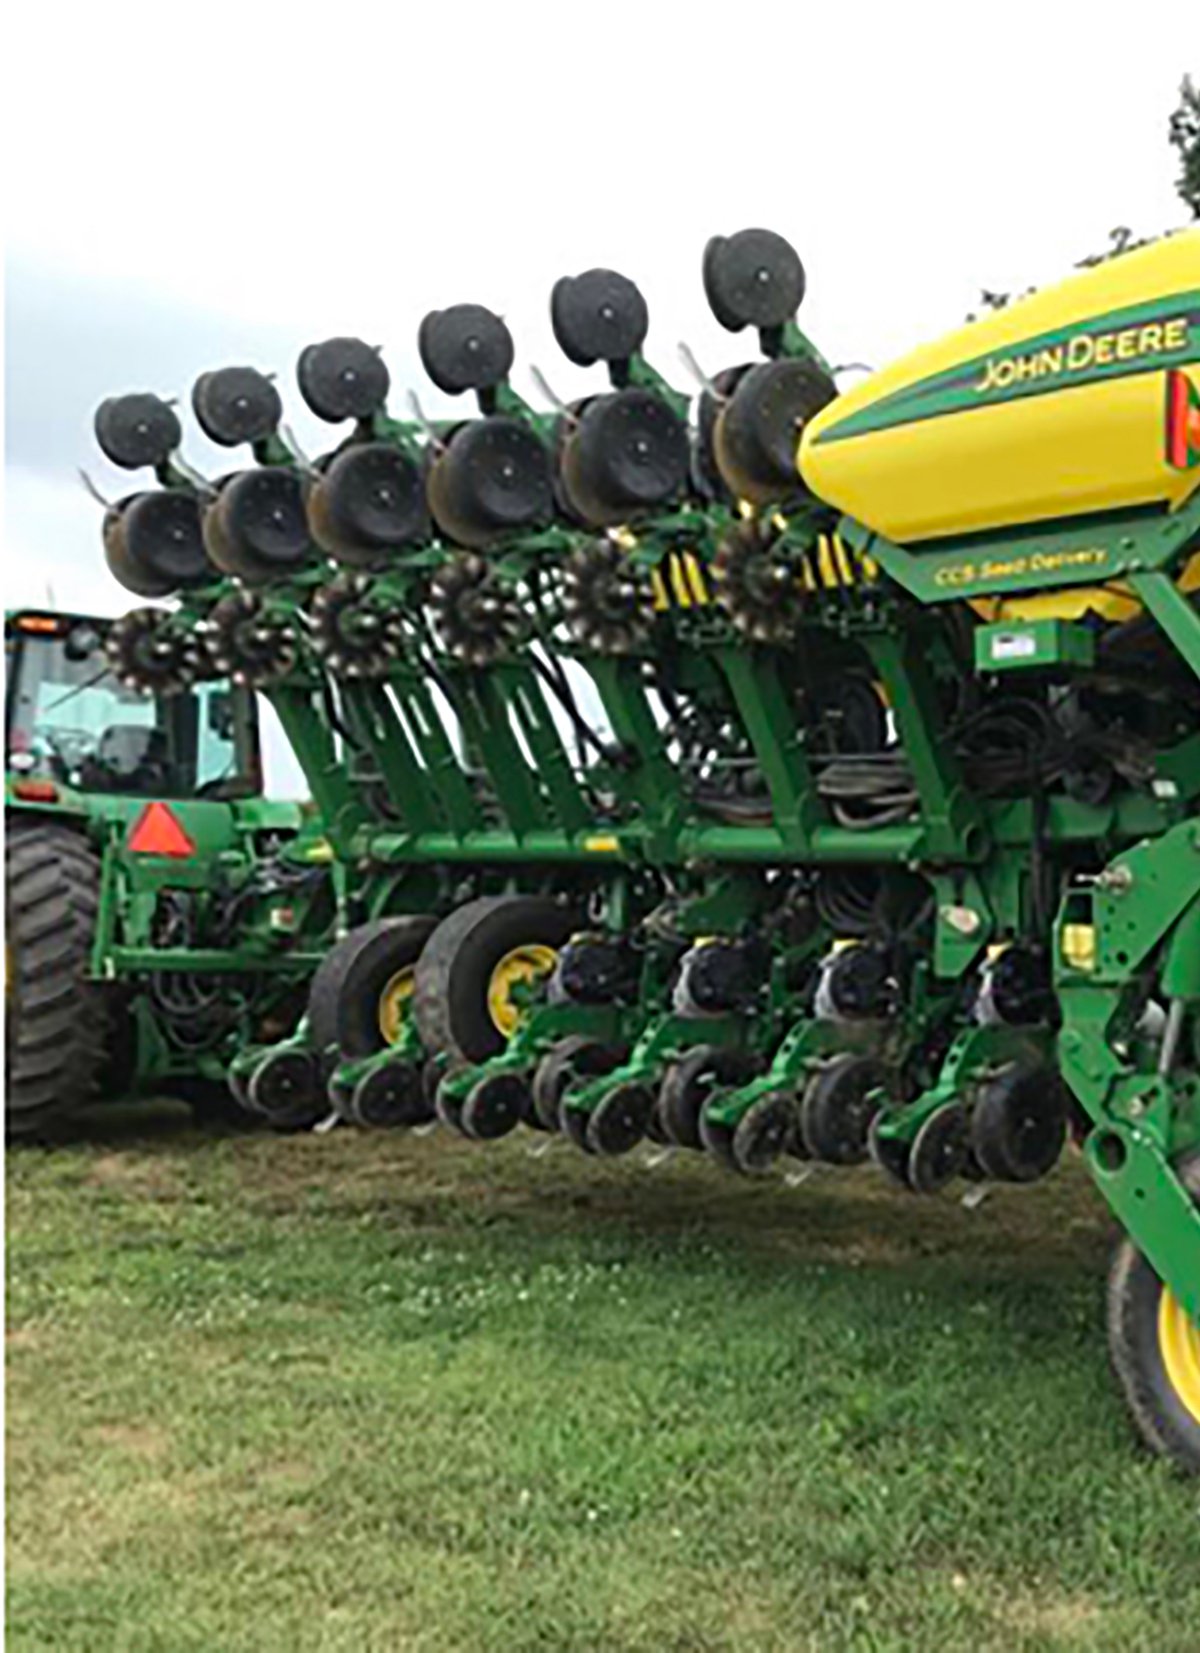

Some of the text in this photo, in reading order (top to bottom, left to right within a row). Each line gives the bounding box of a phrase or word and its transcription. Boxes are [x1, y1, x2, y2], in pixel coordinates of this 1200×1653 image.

[975, 318, 1189, 392] JOHN DEERE
[934, 562, 975, 588] CCS
